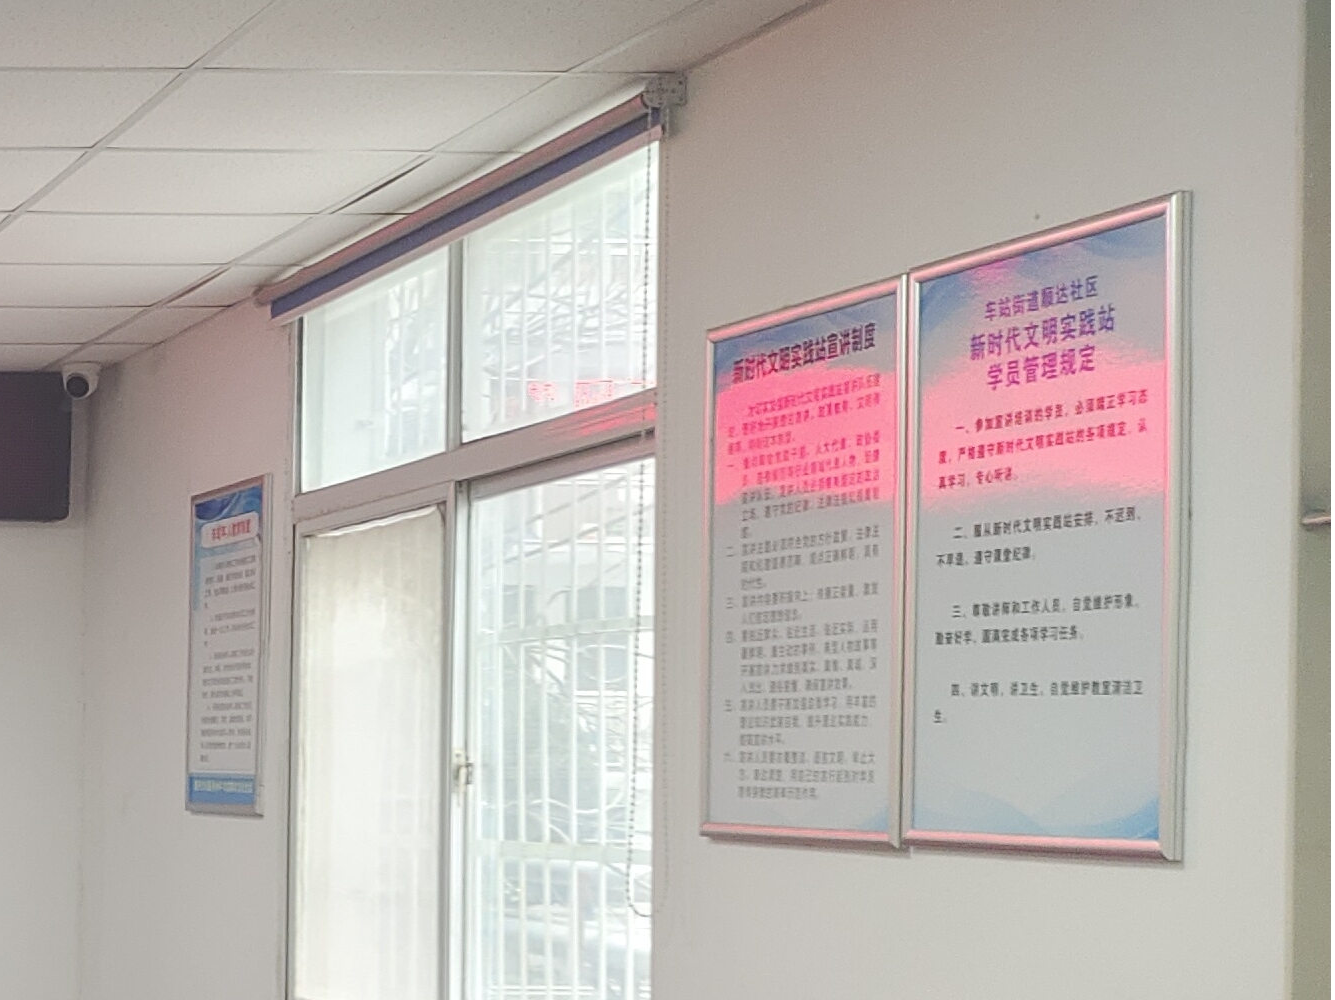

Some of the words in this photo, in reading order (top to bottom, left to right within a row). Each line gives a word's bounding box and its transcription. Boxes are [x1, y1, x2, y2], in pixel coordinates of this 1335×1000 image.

[984, 275, 1099, 321] 车站街道顺达社区
[733, 323, 877, 384] 新时代文明实践站宣讲制度
[970, 303, 1116, 361] 新时代文明实践站
[986, 345, 1096, 390] 学员管理规定
